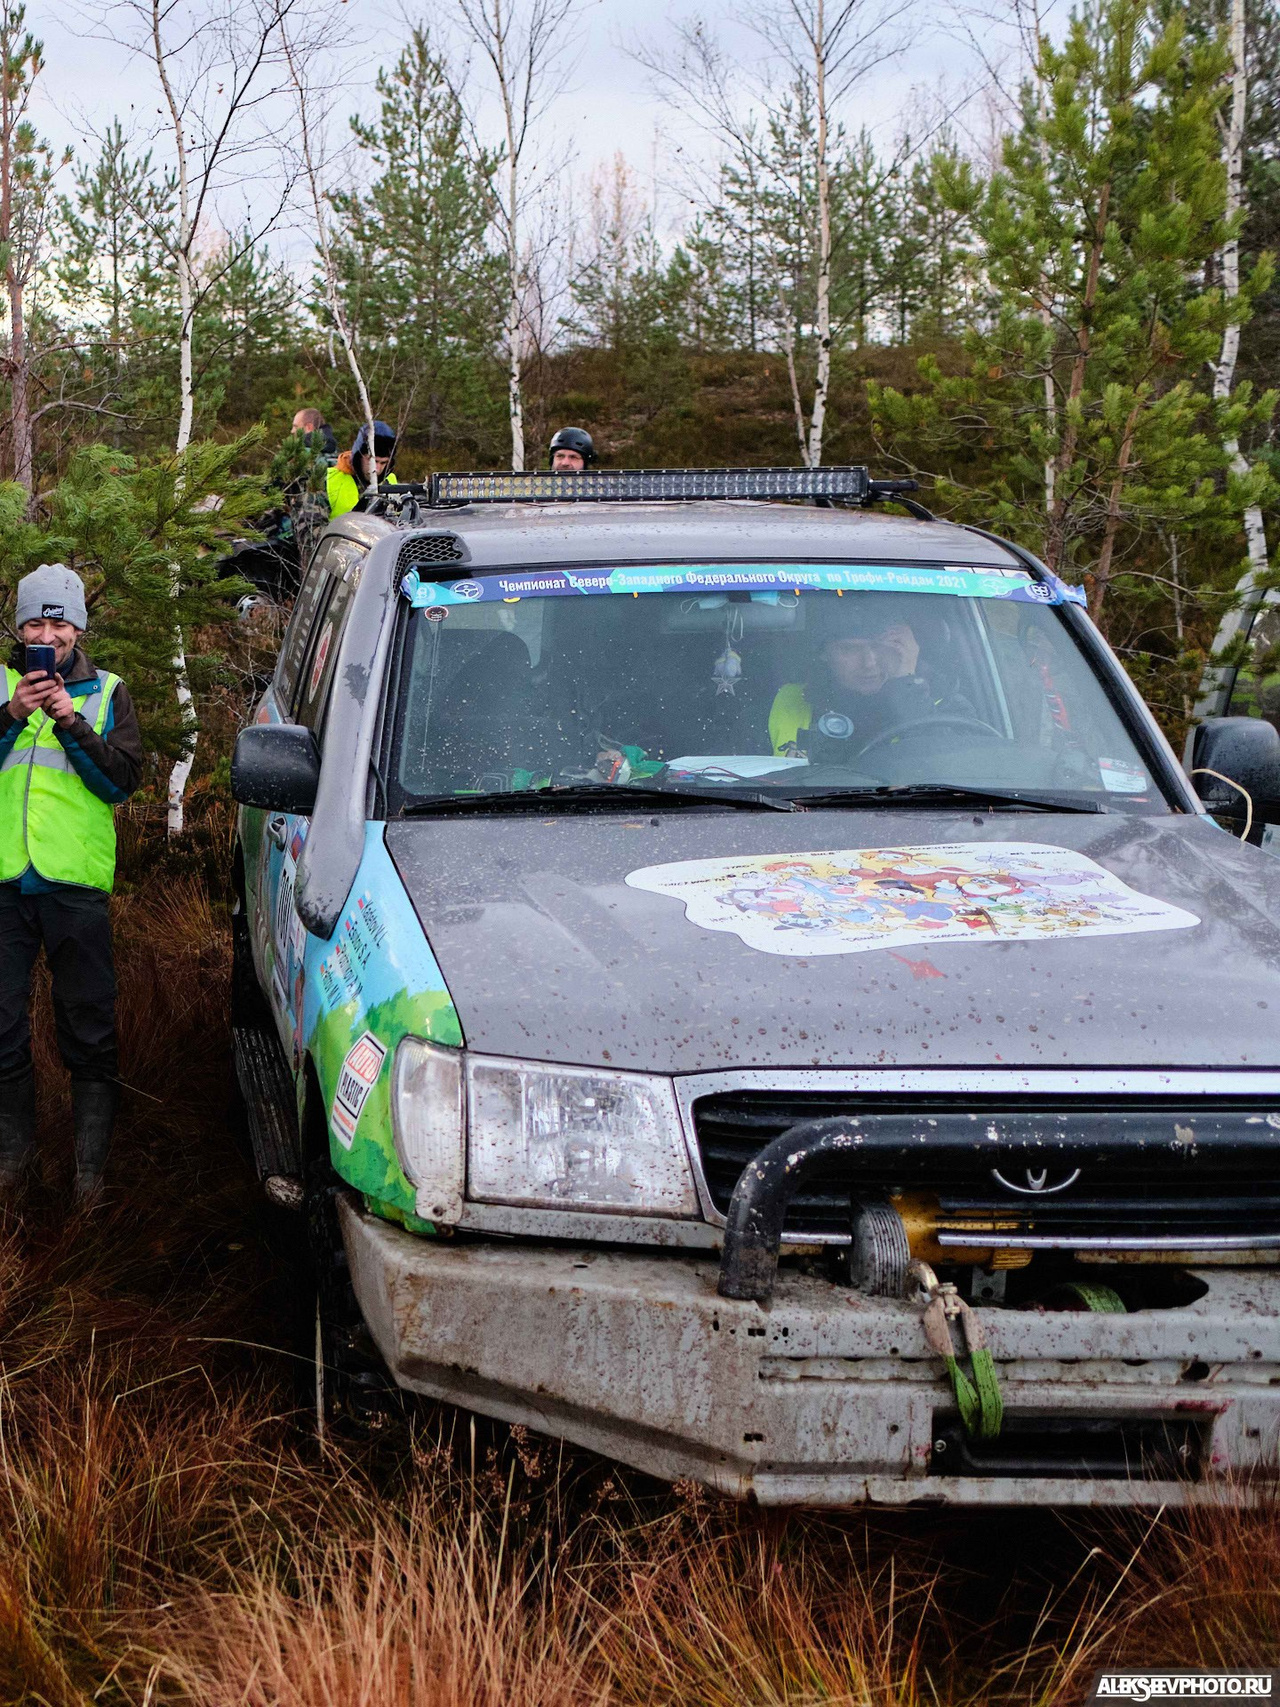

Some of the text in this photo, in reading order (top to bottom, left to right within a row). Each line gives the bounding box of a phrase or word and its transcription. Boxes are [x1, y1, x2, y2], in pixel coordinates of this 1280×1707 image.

[499, 579, 566, 592] Чемпионат
[569, 572, 683, 588] Северо-Западного
[686, 571, 775, 586] Федерального
[777, 570, 820, 585] Округа
[826, 573, 842, 584] по
[936, 574, 968, 589] 2021
